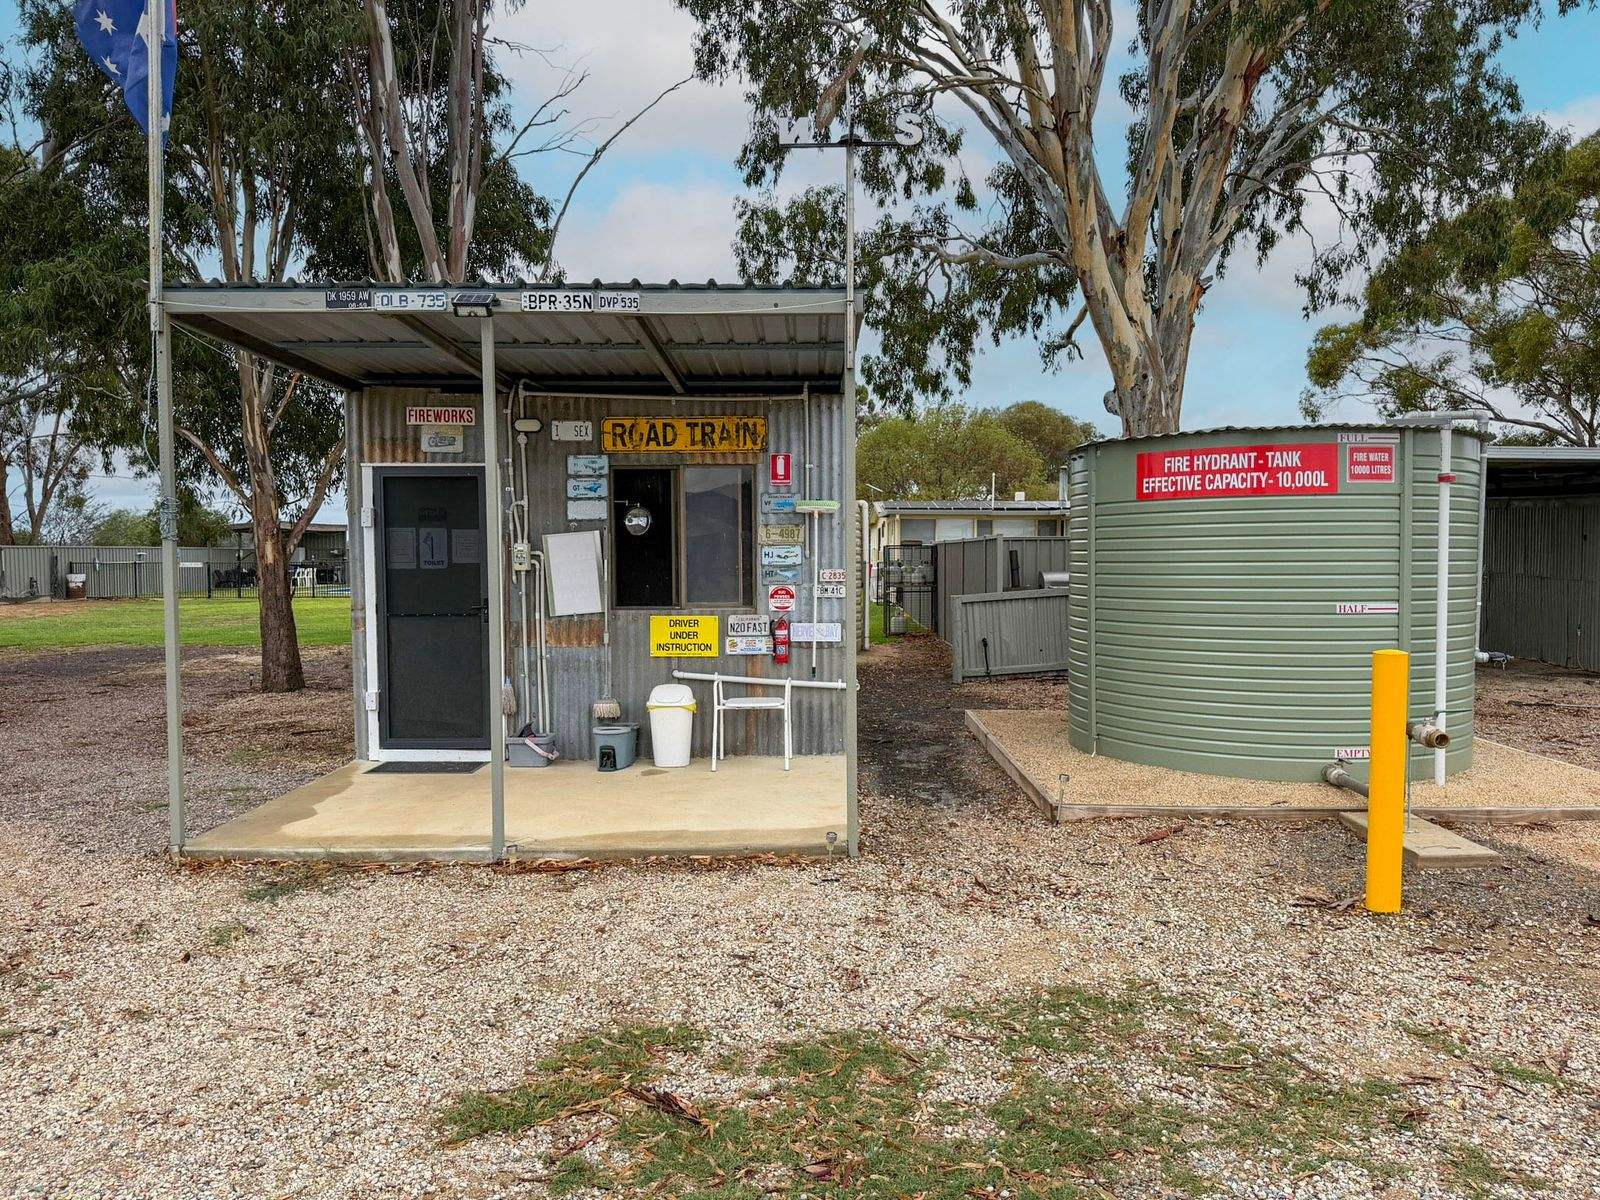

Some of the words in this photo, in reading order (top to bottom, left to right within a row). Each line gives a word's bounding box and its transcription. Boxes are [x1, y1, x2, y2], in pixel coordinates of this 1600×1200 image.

[339, 290, 356, 301] 1959
[358, 290, 370, 300] AW
[600, 296, 618, 309] DVP
[621, 297, 639, 309] 535
[408, 409, 474, 423] FIREWORKS
[574, 427, 589, 437] SEX
[611, 422, 678, 447] ROAD
[685, 421, 759, 448] TRAIN
[1165, 455, 1190, 473] FIRE
[1194, 452, 1257, 471] HYDRANT
[1265, 451, 1302, 468] TANK
[1353, 453, 1367, 462] FIRE
[1369, 453, 1389, 462] WATER
[1372, 465, 1392, 475] LITRES
[1143, 474, 1202, 493] EFFECTIVE
[1276, 470, 1329, 490] 10,000L
[764, 551, 774, 559] HJ
[1338, 604, 1367, 613] HALF
[669, 619, 699, 628] DRIVER
[669, 631, 699, 640] UNDER
[656, 643, 712, 652] INSTRUCTION
